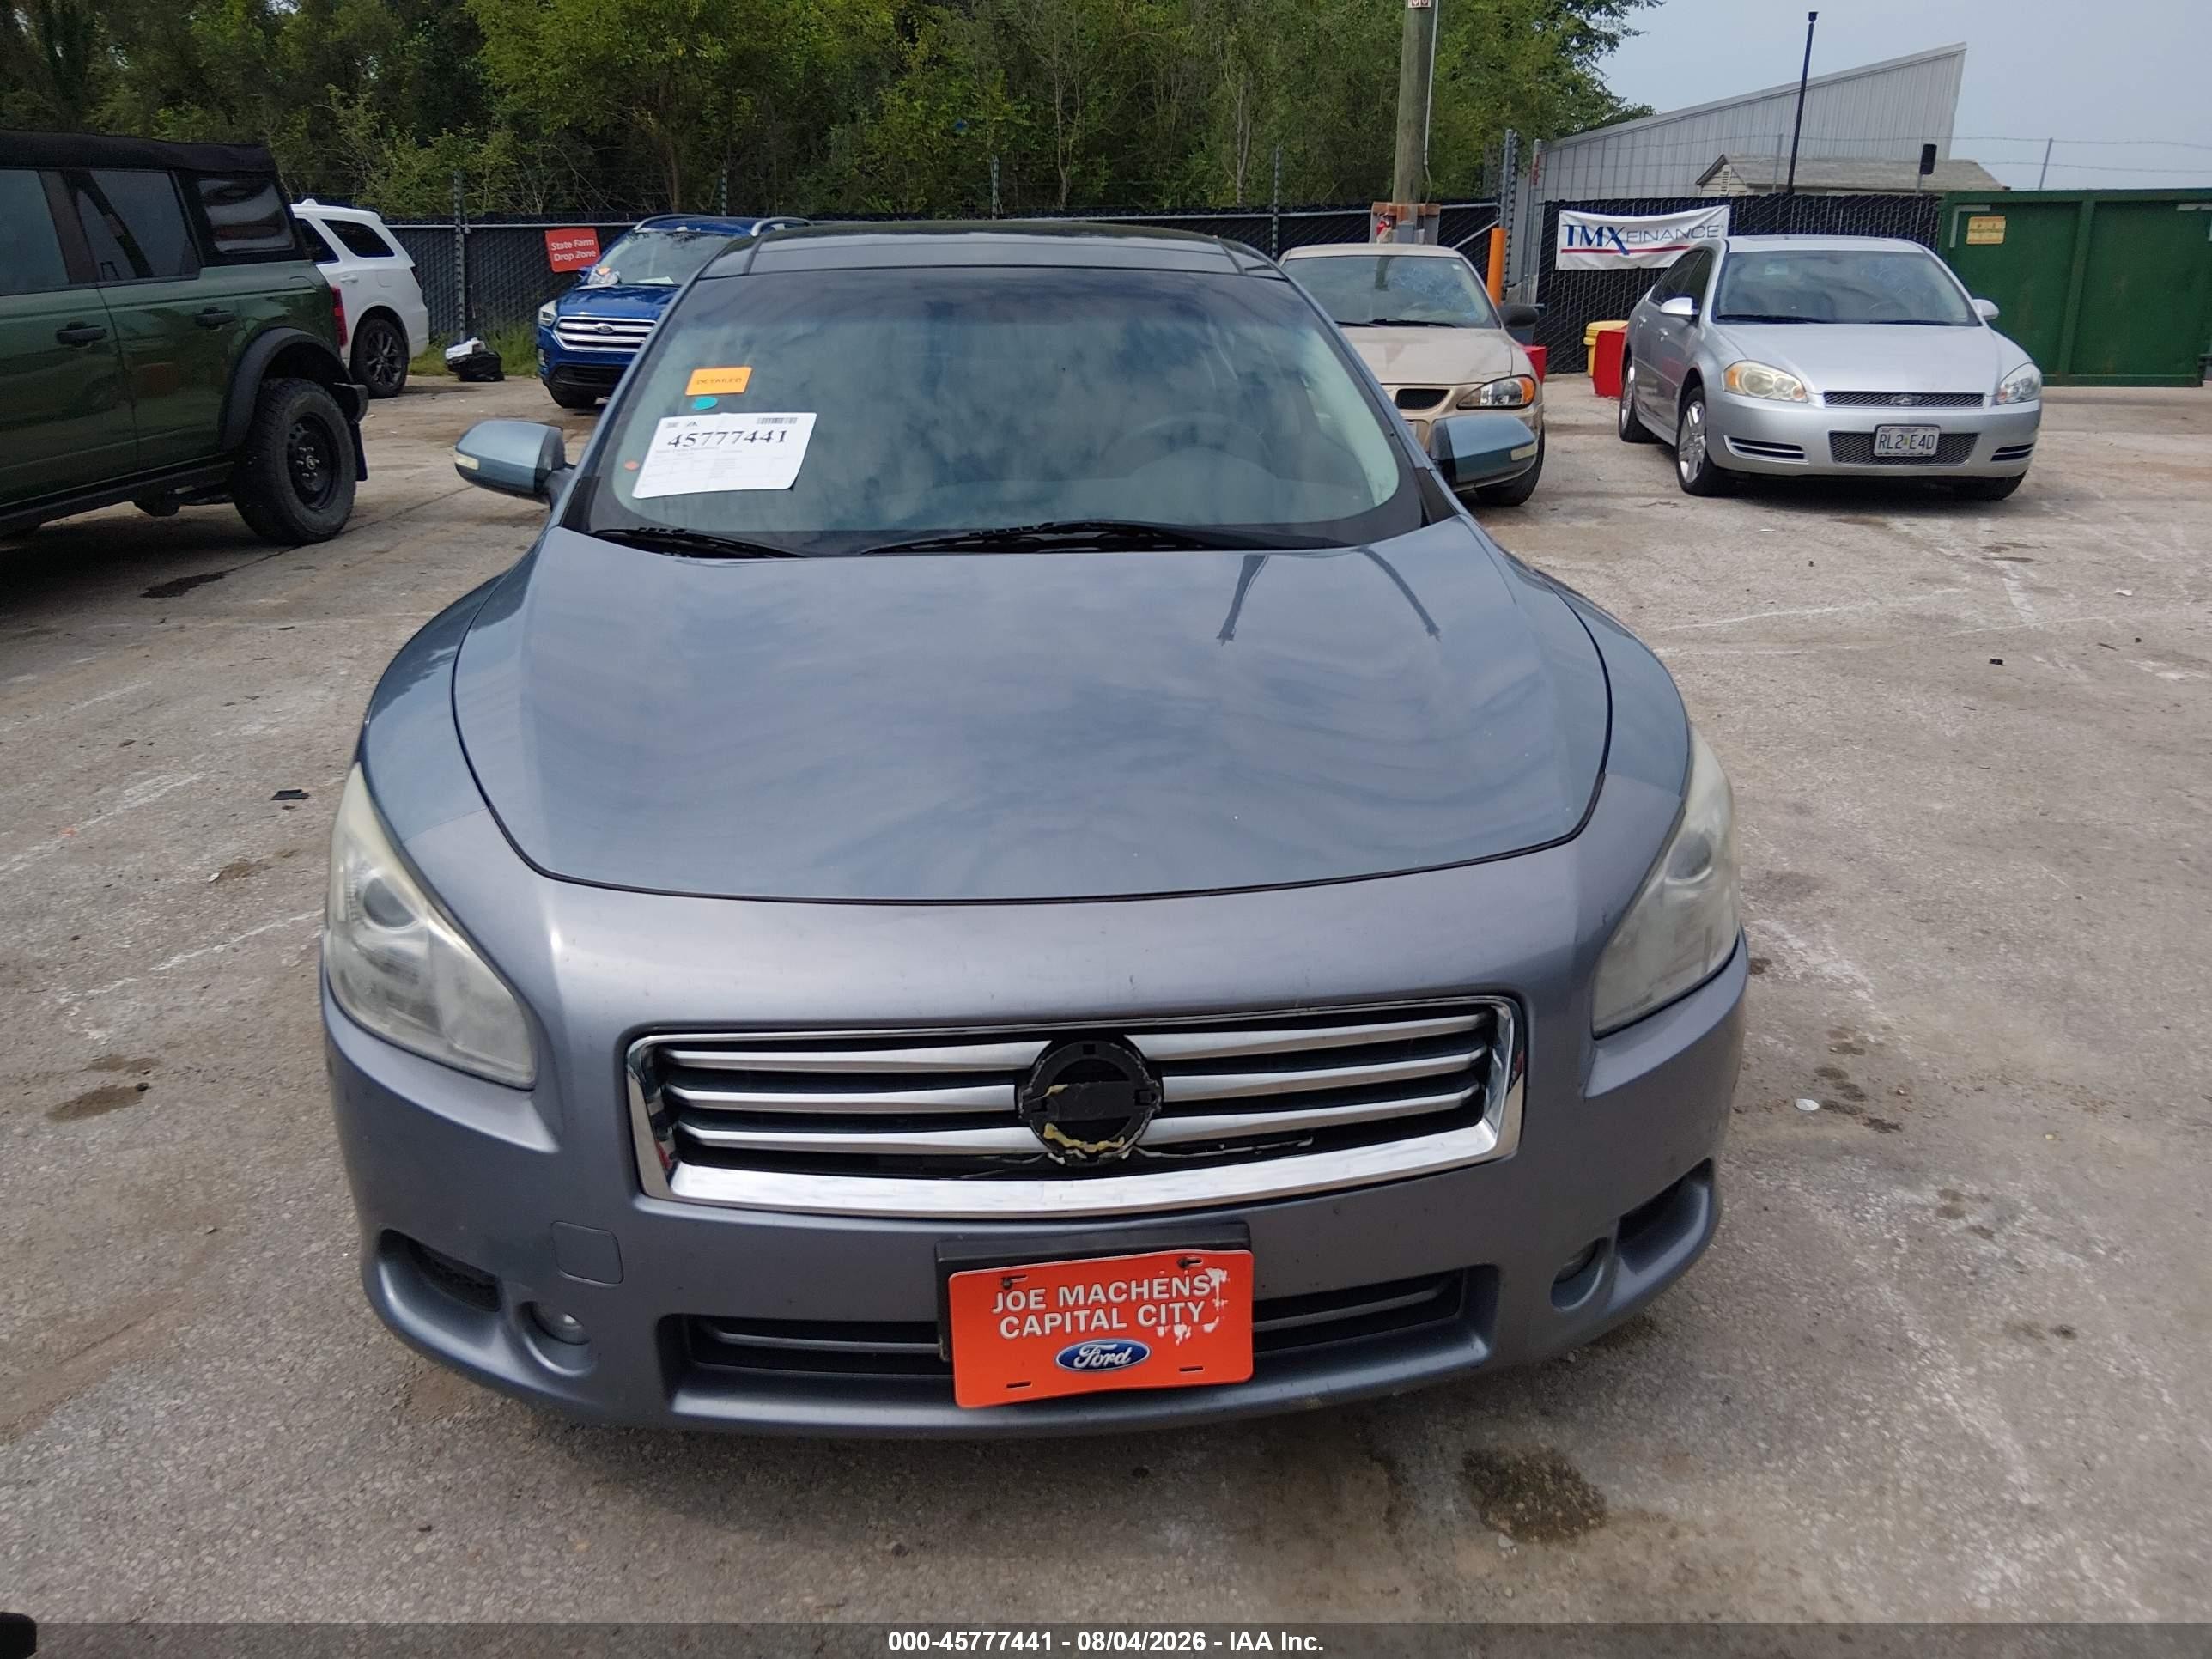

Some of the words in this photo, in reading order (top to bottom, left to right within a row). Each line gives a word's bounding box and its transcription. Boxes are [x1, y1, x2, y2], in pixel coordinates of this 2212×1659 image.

[550, 242, 573, 251] State
[574, 239, 595, 247] Farm
[1562, 224, 1630, 256] TMX
[1626, 225, 1719, 243] FINANCE
[553, 253, 574, 262] Drop
[575, 250, 597, 259] Zone
[667, 429, 787, 447] 45777441
[1878, 434, 1904, 449] RL2
[993, 1288, 1046, 1314] JOE
[1058, 1273, 1212, 1308] MACHENS
[1000, 1307, 1127, 1339] CAPITAL
[1138, 1301, 1206, 1327] CITY
[1073, 1344, 1133, 1369] Ford
